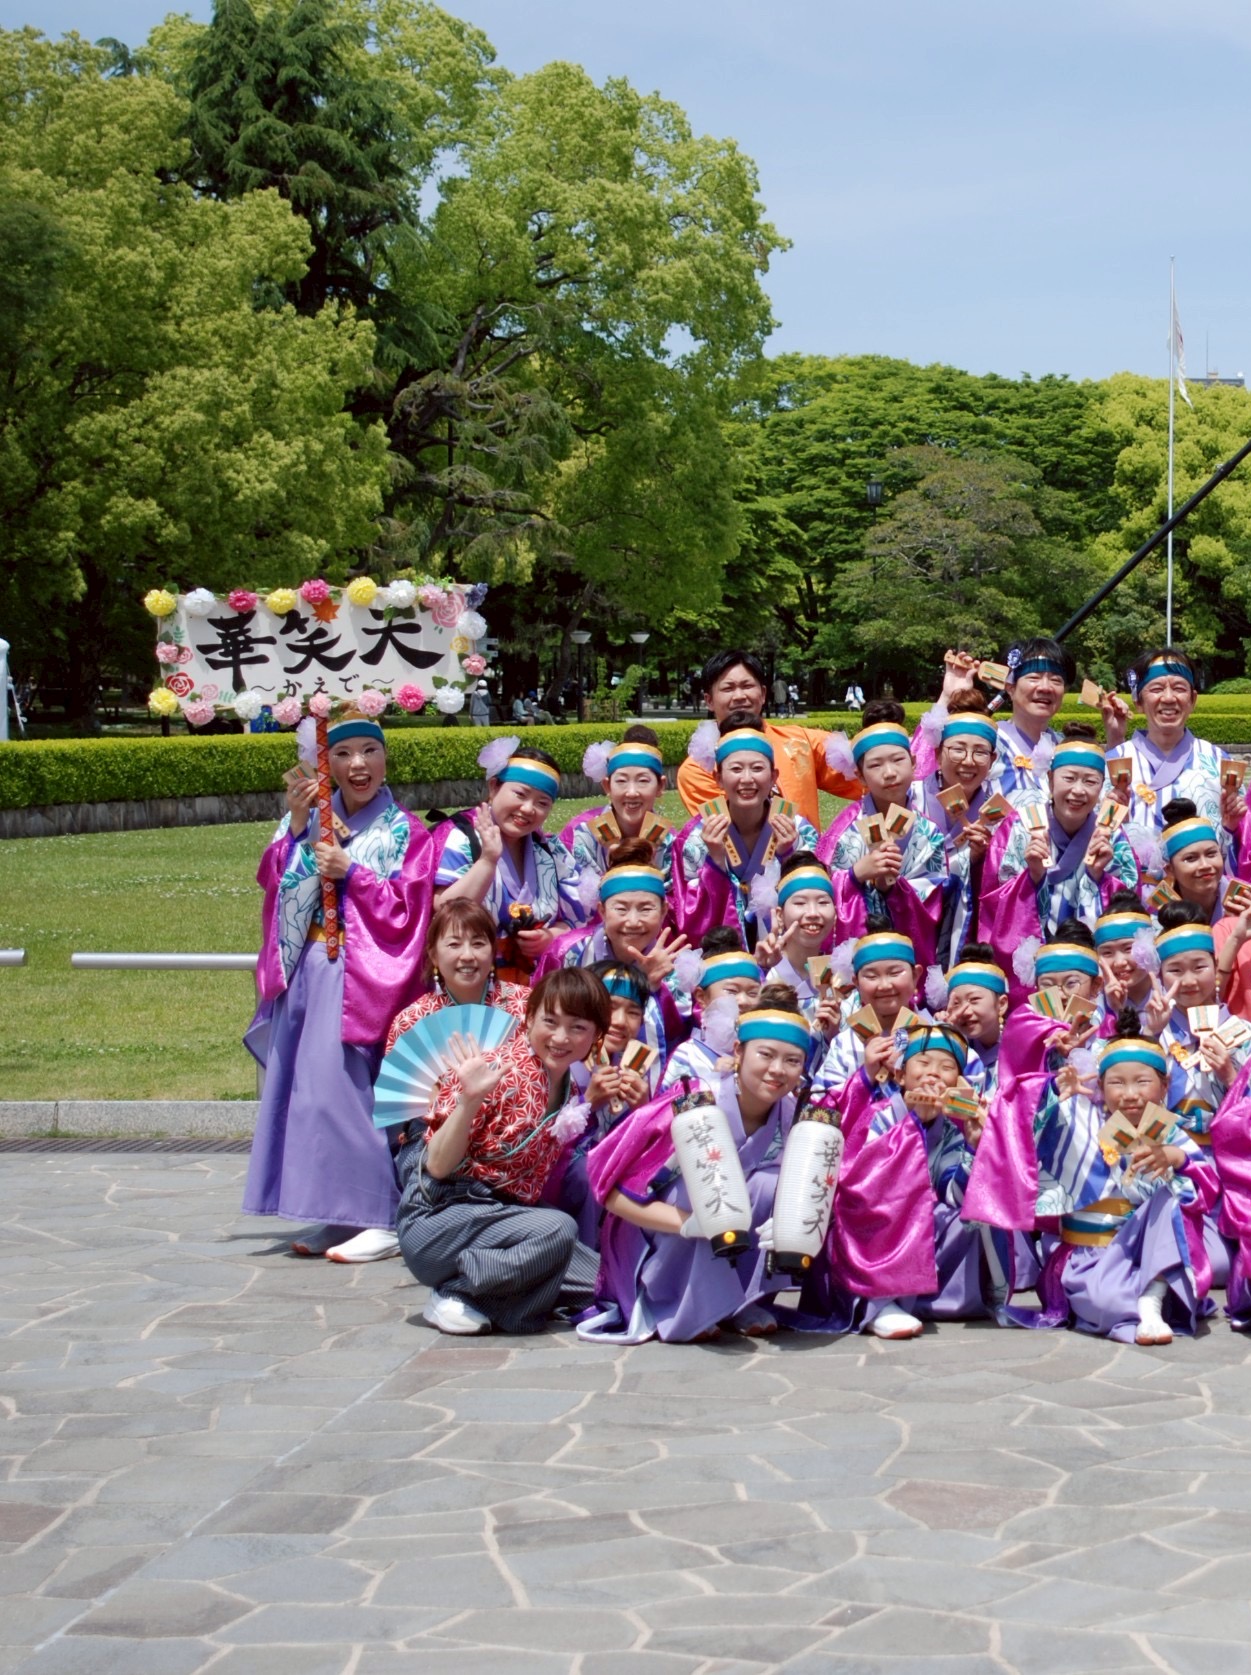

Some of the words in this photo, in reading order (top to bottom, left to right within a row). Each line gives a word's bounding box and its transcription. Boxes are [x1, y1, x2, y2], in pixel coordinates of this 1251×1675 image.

[196, 608, 445, 694] 華笑天
[685, 1113, 744, 1216] 華笑天
[802, 1138, 842, 1243] 華笑天
